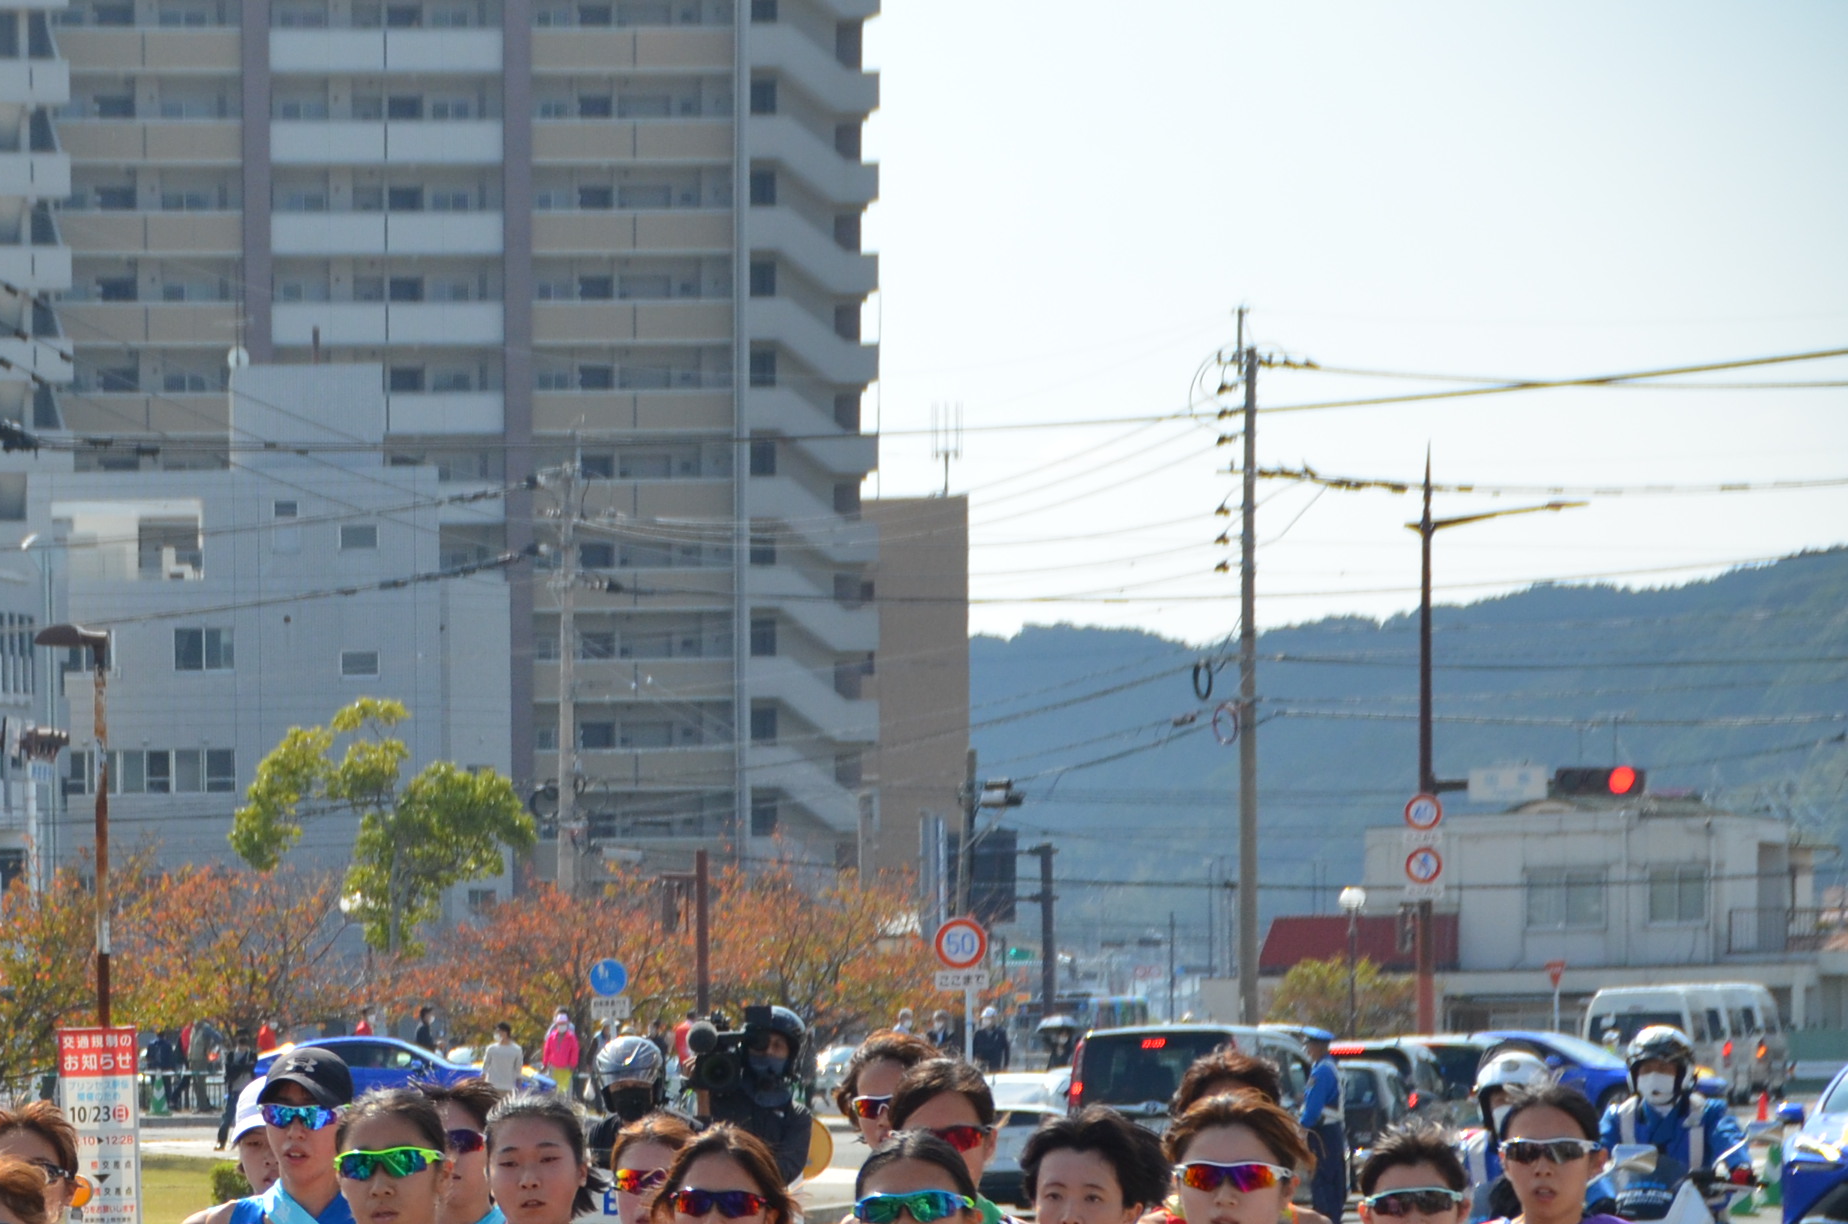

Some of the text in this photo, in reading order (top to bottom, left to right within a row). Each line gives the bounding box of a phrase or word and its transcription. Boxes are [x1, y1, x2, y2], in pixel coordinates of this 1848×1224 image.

[946, 932, 976, 955] 50
[939, 973, 985, 987] ここまで
[62, 1034, 132, 1050] 交通規制の
[63, 1052, 132, 1071] お知らせ
[69, 1104, 111, 1123] 10/23
